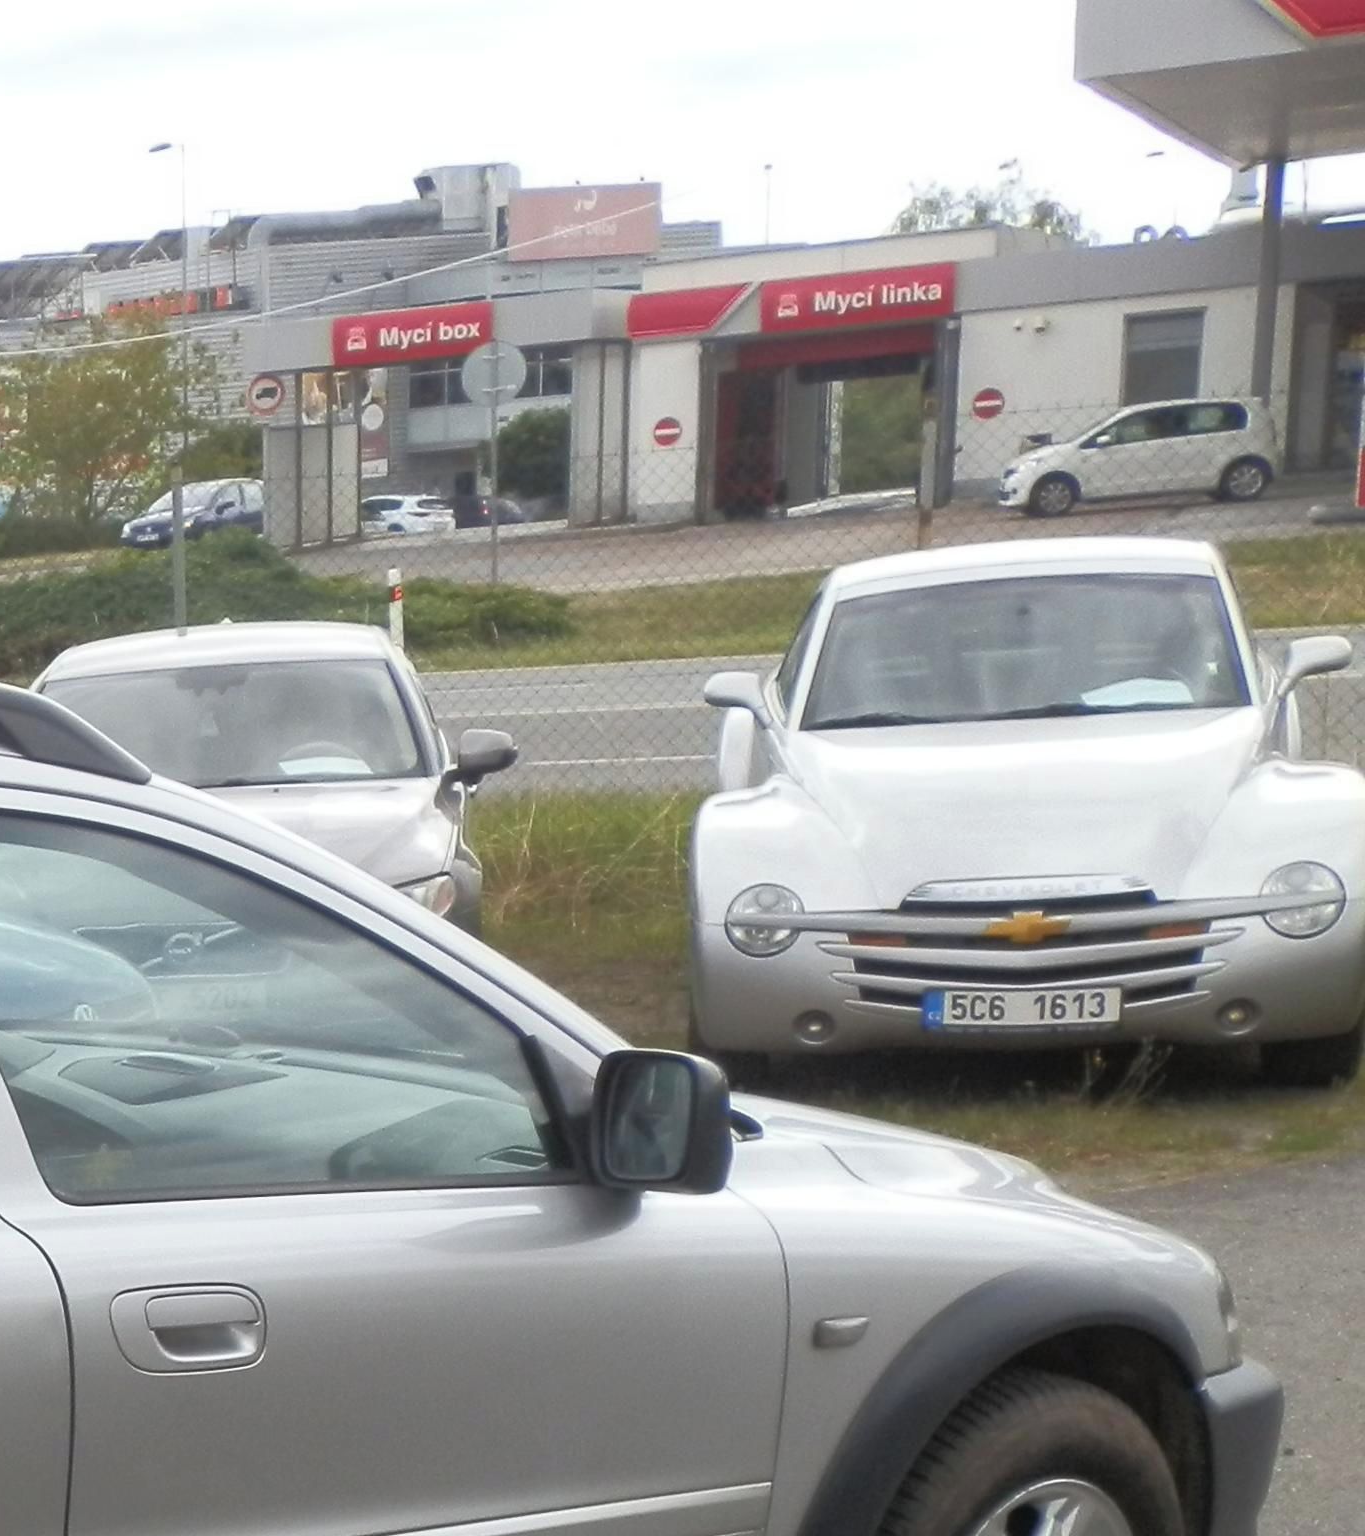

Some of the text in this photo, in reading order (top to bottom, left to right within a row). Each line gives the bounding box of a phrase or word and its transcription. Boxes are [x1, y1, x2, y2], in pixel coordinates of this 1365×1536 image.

[814, 282, 942, 315] Mycí linka
[379, 320, 481, 350] Mycí box
[951, 994, 1006, 1021] 5C6
[1033, 991, 1106, 1021] 1613
